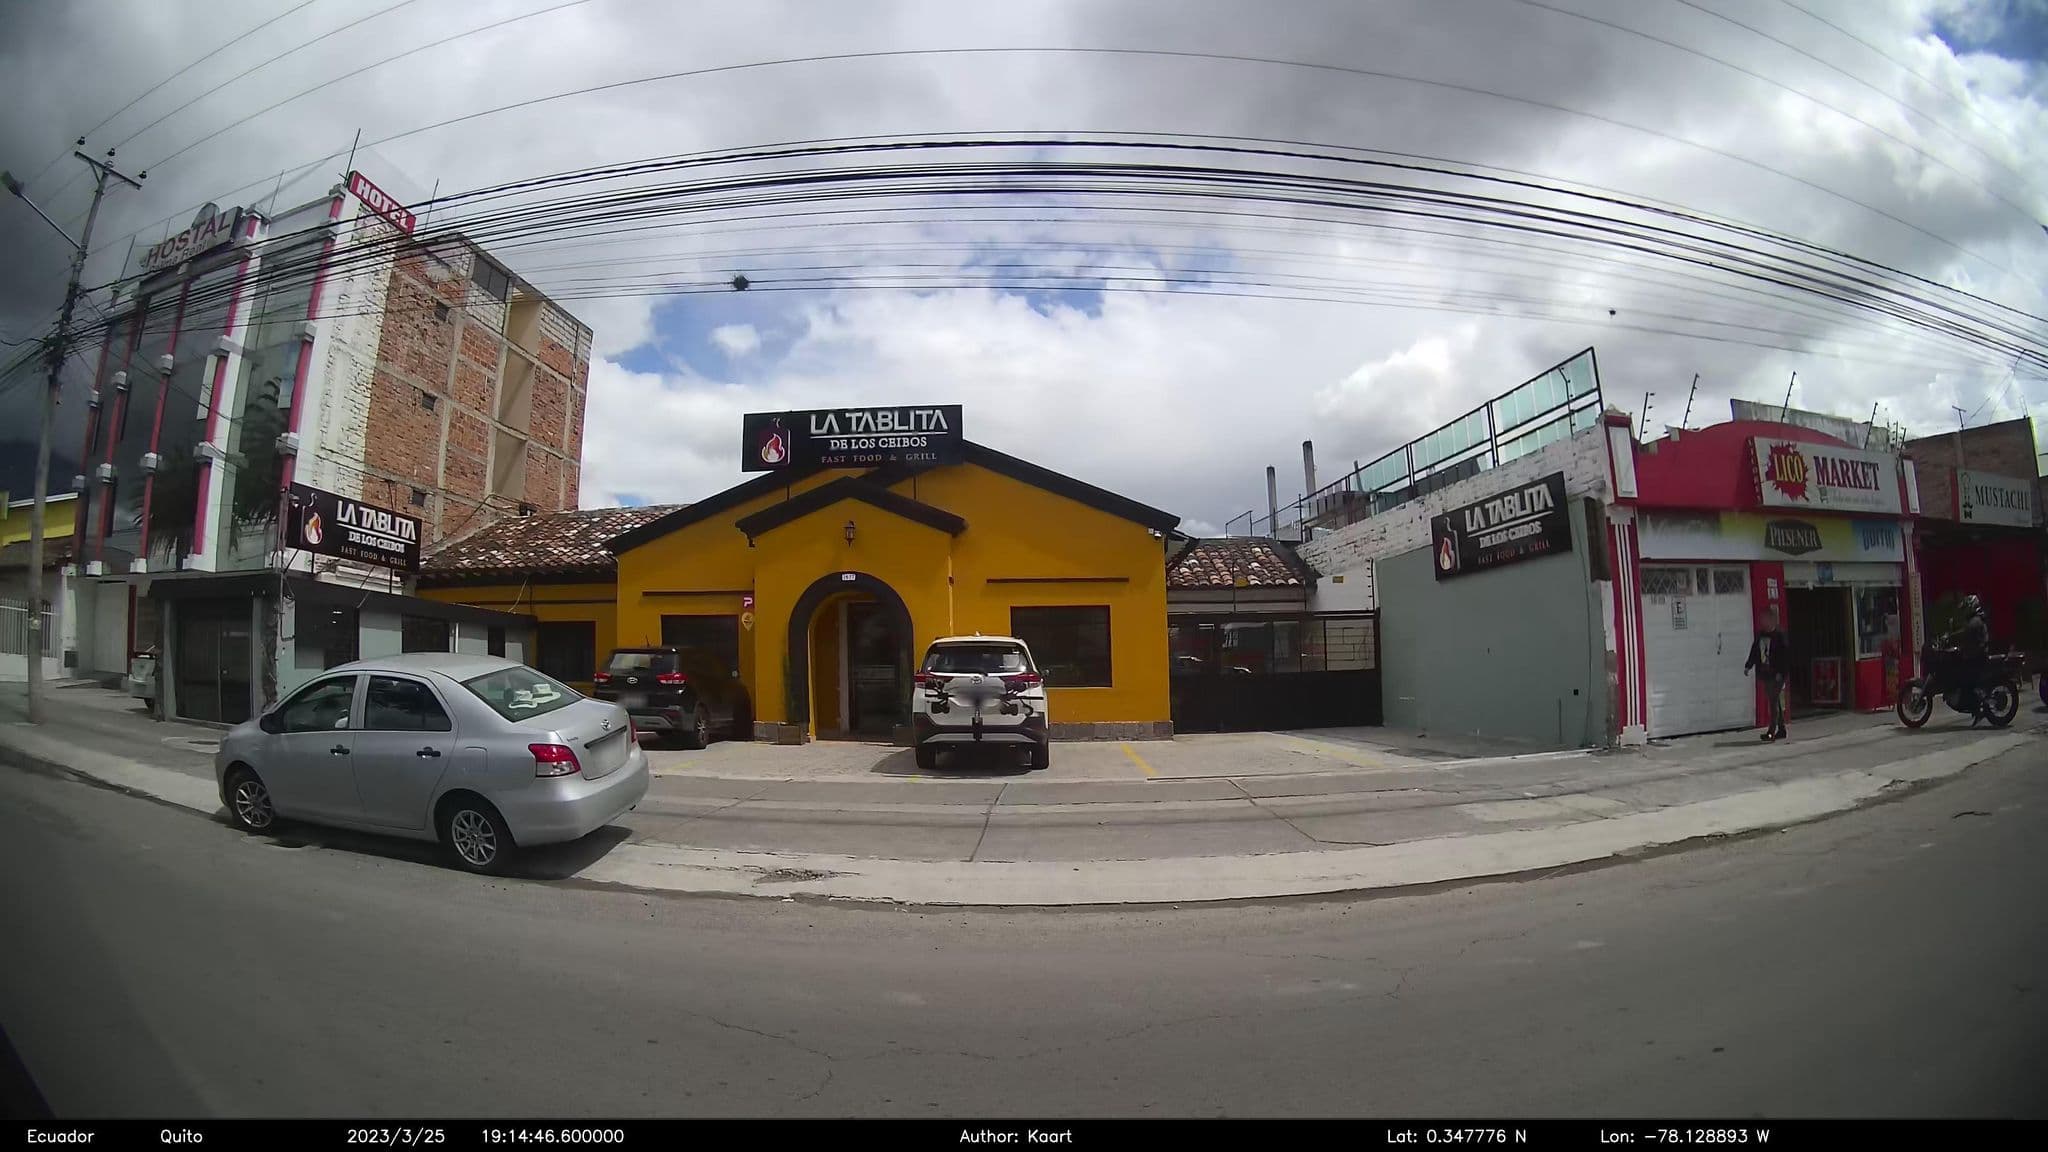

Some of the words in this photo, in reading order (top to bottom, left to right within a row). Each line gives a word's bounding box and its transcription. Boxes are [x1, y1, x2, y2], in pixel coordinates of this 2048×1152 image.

[356, 179, 408, 229] HOTEL
[145, 211, 231, 267] HOSTAL
[810, 413, 840, 434] LA
[845, 409, 949, 433] TABLITA
[821, 455, 845, 463] FAST
[853, 454, 882, 462] FOOD
[906, 452, 937, 461] GRILL
[830, 439, 848, 450] DE
[851, 438, 876, 449] LOS
[878, 436, 927, 448] CEIBOS
[1774, 453, 1804, 483] LICO
[1813, 456, 1880, 491] MARKET
[336, 500, 357, 525] LA
[359, 506, 416, 540] TABLITA
[1465, 507, 1486, 532] LA
[1485, 483, 1554, 525] TABLITA
[348, 531, 360, 543] DE
[361, 534, 377, 547] LOS
[1769, 525, 1819, 548] PILSENER
